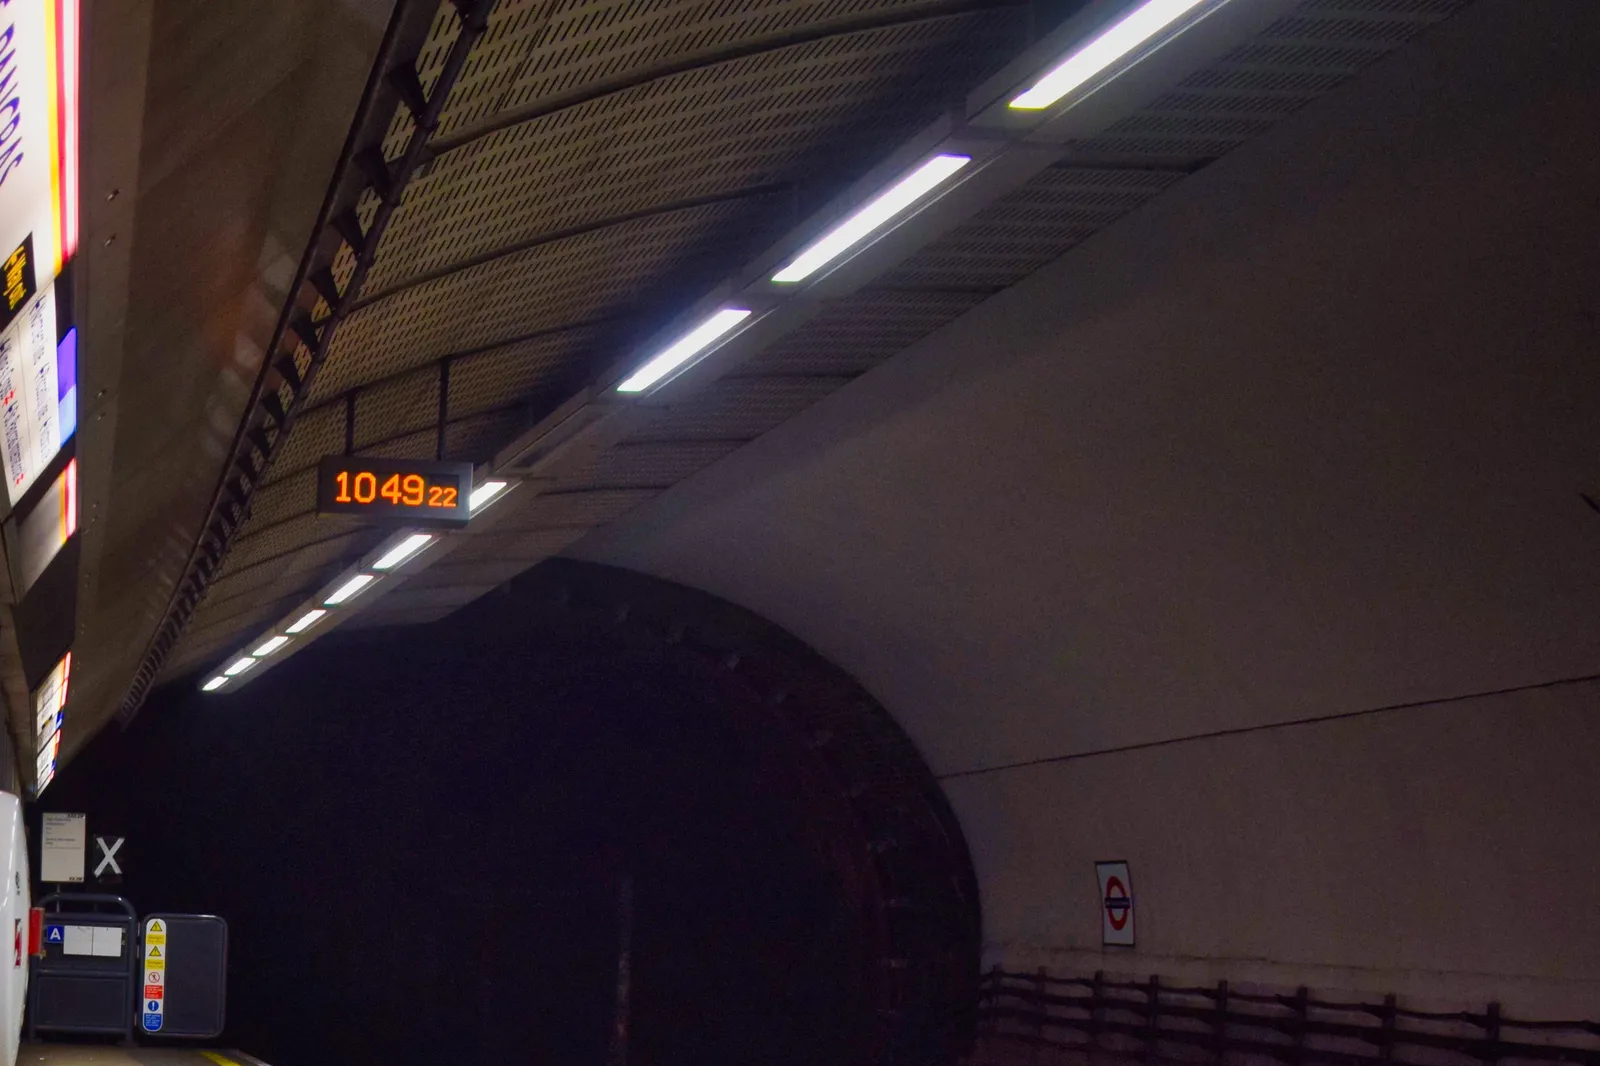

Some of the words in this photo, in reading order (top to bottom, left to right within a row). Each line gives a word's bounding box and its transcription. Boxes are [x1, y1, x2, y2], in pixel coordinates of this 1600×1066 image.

[3, 252, 27, 297] Way
[8, 281, 27, 311] out
[49, 927, 62, 940] A
